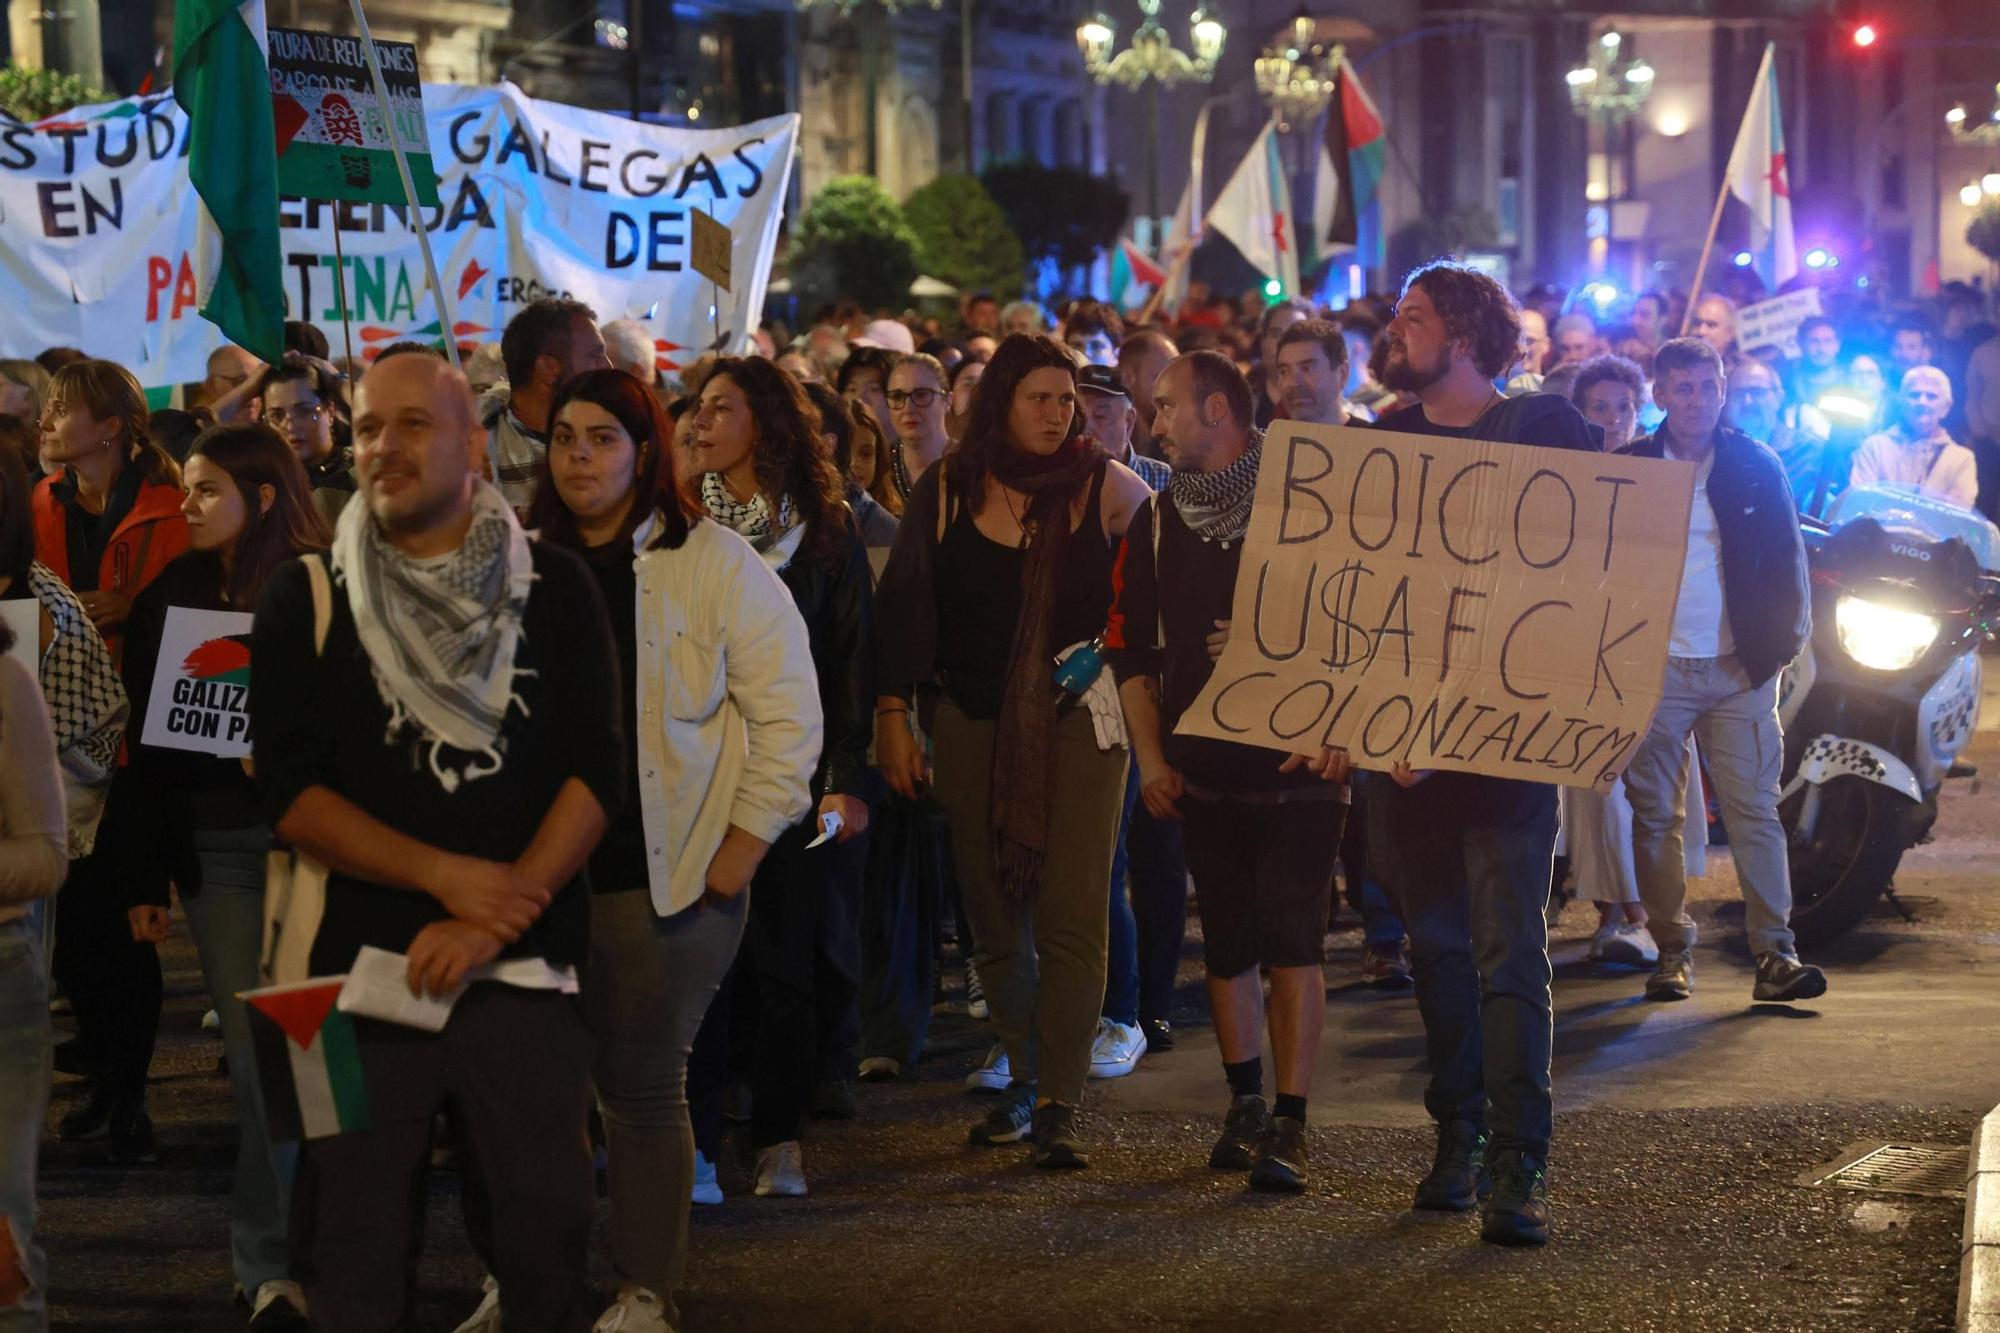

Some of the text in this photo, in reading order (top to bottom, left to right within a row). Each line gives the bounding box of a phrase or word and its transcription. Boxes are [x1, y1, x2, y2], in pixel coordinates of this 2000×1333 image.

[315, 36, 334, 63] DE
[363, 81, 420, 113] AMAS
[0, 111, 765, 200] STUD GALEGAS
[36, 176, 125, 238] EN
[605, 211, 685, 272] DE
[1278, 435, 1637, 573] BOICOT
[1890, 542, 1931, 562] VIGO
[166, 706, 220, 739] CON
